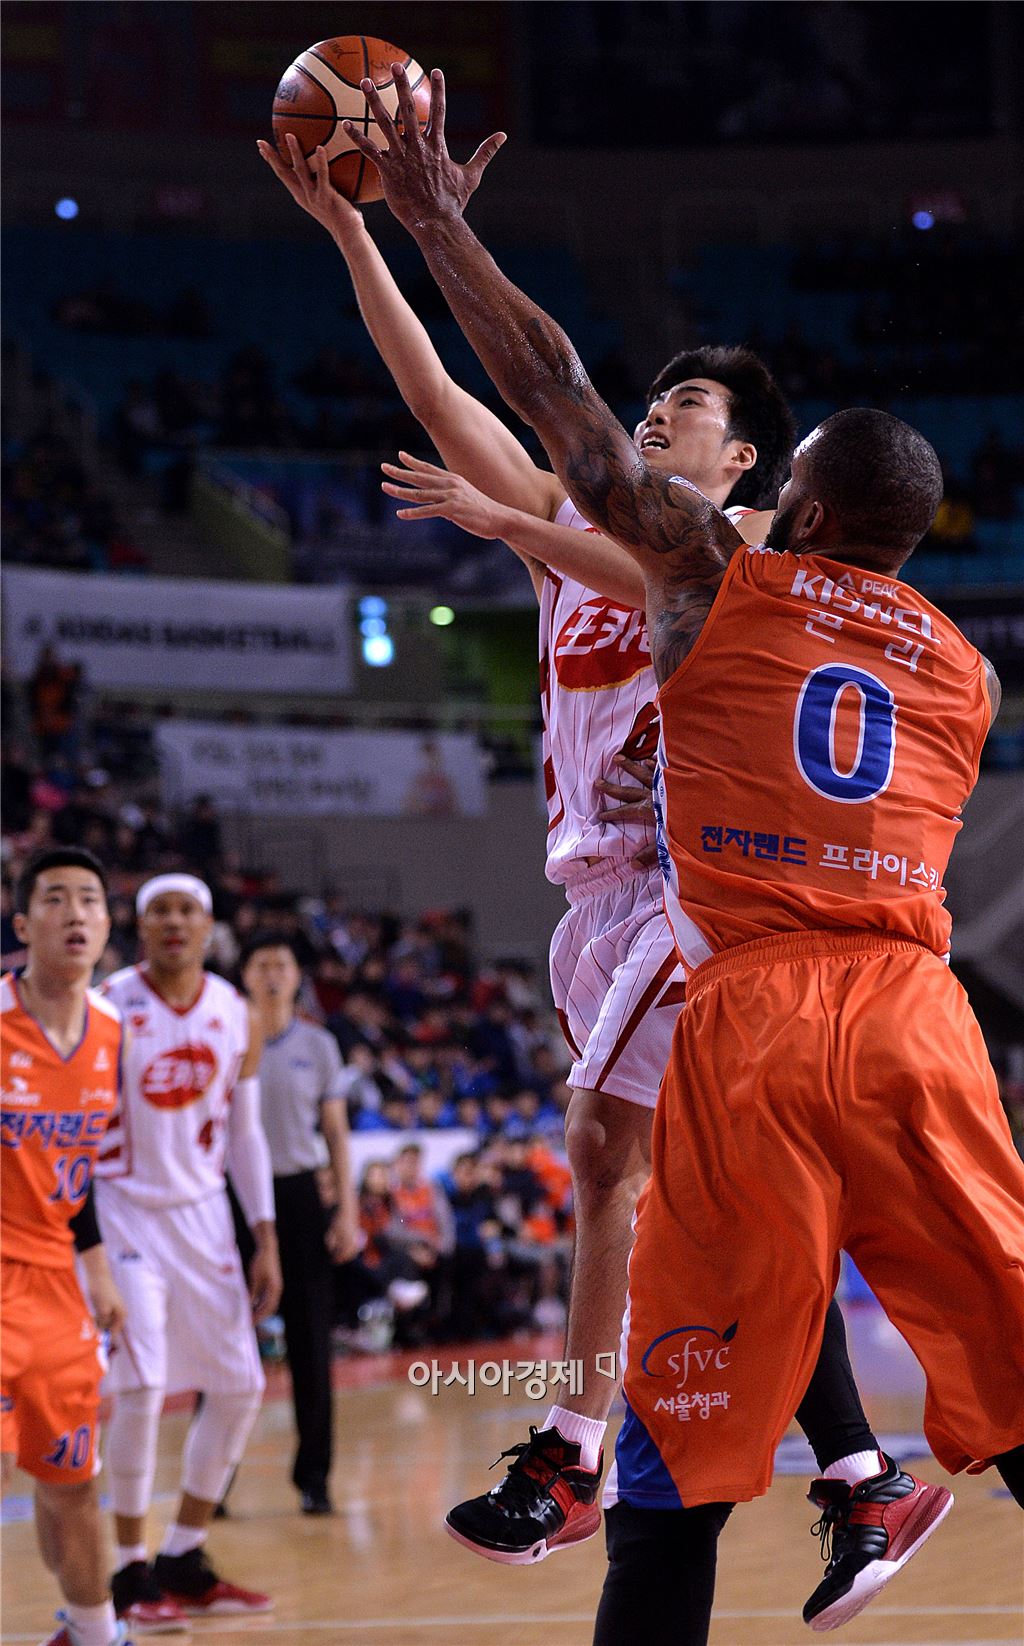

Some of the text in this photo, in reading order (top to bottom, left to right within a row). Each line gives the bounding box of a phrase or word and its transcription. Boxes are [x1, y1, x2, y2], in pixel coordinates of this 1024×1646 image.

[790, 569, 942, 645] KISWEL
[861, 578, 902, 600] PEAK
[793, 662, 897, 804] 0
[701, 825, 807, 866] 전자랜드
[49, 1156, 92, 1204] 10
[667, 1337, 731, 1388] sfvc
[653, 1391, 731, 1422] 서울청과
[44, 1423, 91, 1469] 10
